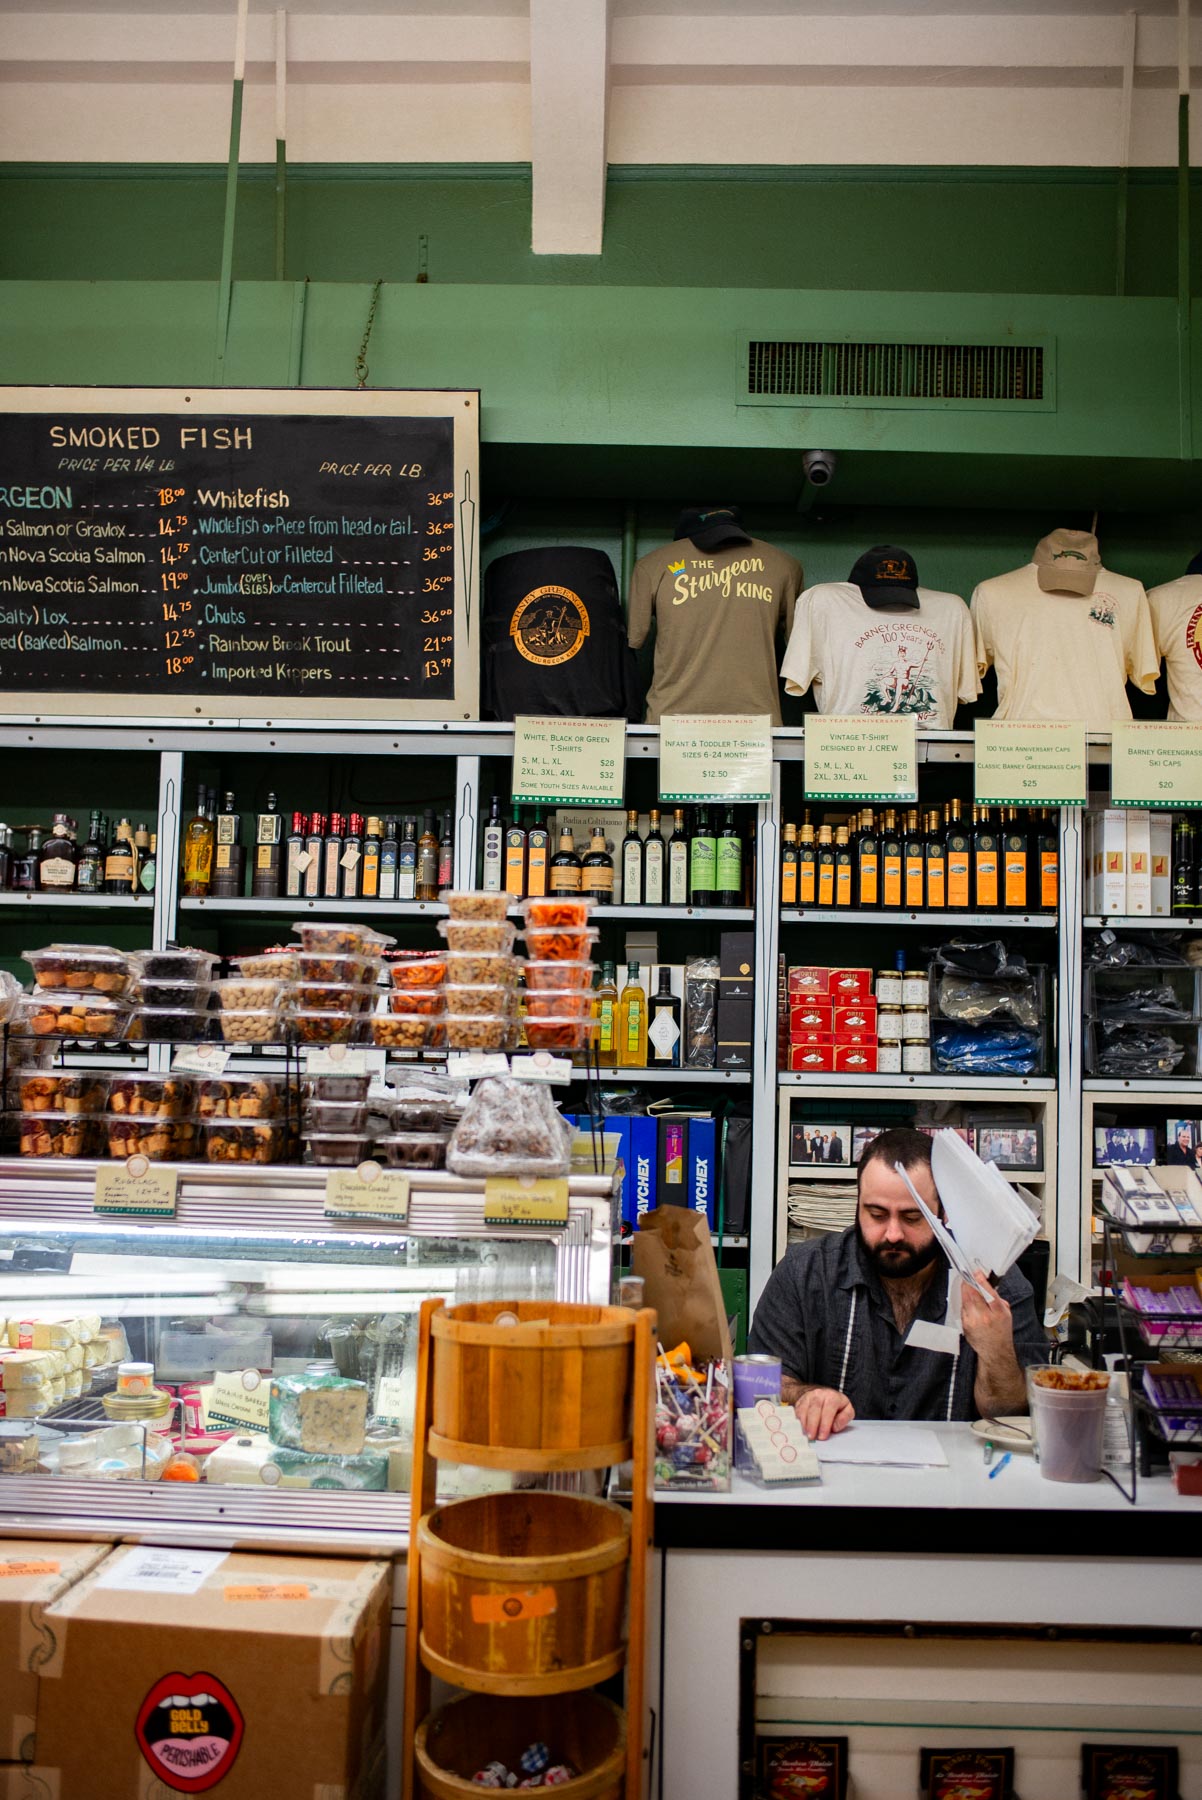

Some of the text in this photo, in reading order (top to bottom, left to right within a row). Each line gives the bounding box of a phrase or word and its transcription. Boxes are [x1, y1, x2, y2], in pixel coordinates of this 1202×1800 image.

[50, 426, 252, 450] SMOKED FISH
[58, 457, 99, 472] PRICE
[103, 458, 131, 472] PER
[158, 460, 175, 472] LB
[319, 461, 361, 476] PRICE
[364, 464, 392, 476] PER
[197, 488, 290, 508] Whitefish
[6, 519, 54, 537] Salmon
[56, 524, 73, 536] or
[76, 520, 126, 538] Gravlox
[262, 523, 275, 534] or
[276, 516, 306, 534] Piece
[309, 515, 338, 535] from
[342, 515, 371, 536] head
[374, 522, 388, 535] or
[390, 515, 411, 535] tail
[9, 547, 46, 563] Nova
[48, 547, 91, 564] Scotia
[94, 547, 145, 564] Salmon
[267, 550, 282, 563] or
[285, 545, 333, 564] Filleted
[690, 560, 715, 569] THE
[12, 576, 43, 592] Nova
[44, 576, 86, 593] Scotia
[87, 574, 140, 593] Salmon
[272, 583, 284, 594] or
[339, 572, 384, 594] Filleted
[672, 558, 765, 606] Sturgeon
[736, 582, 773, 603] KING
[43, 607, 70, 625] Lox
[205, 603, 246, 624] Chubs
[511, 592, 537, 634] BARNEY
[71, 635, 122, 651] Salmon
[209, 634, 269, 652] Rainbow
[314, 635, 352, 653] Trout
[855, 624, 889, 649] BARNEY
[881, 632, 923, 645] 100 Years
[520, 646, 578, 665] THE STURGEON KING
[212, 662, 273, 682] Imported
[550, 734, 573, 742] BLACK
[586, 735, 610, 743] GREEN
[550, 744, 582, 752] T-SHIRTS
[1127, 748, 1154, 756] BARNEY
[1149, 759, 1161, 767] SKI
[560, 769, 614, 779] 4XL $32
[702, 770, 728, 778] $12.50
[853, 773, 908, 782] 4XL $32
[563, 815, 582, 824] Badia
[587, 816, 623, 826] Coltibuono
[695, 1157, 708, 1215] AYCHEX
[169, 1709, 202, 1721] GOLD
[160, 1742, 221, 1768] PERISHABLE
